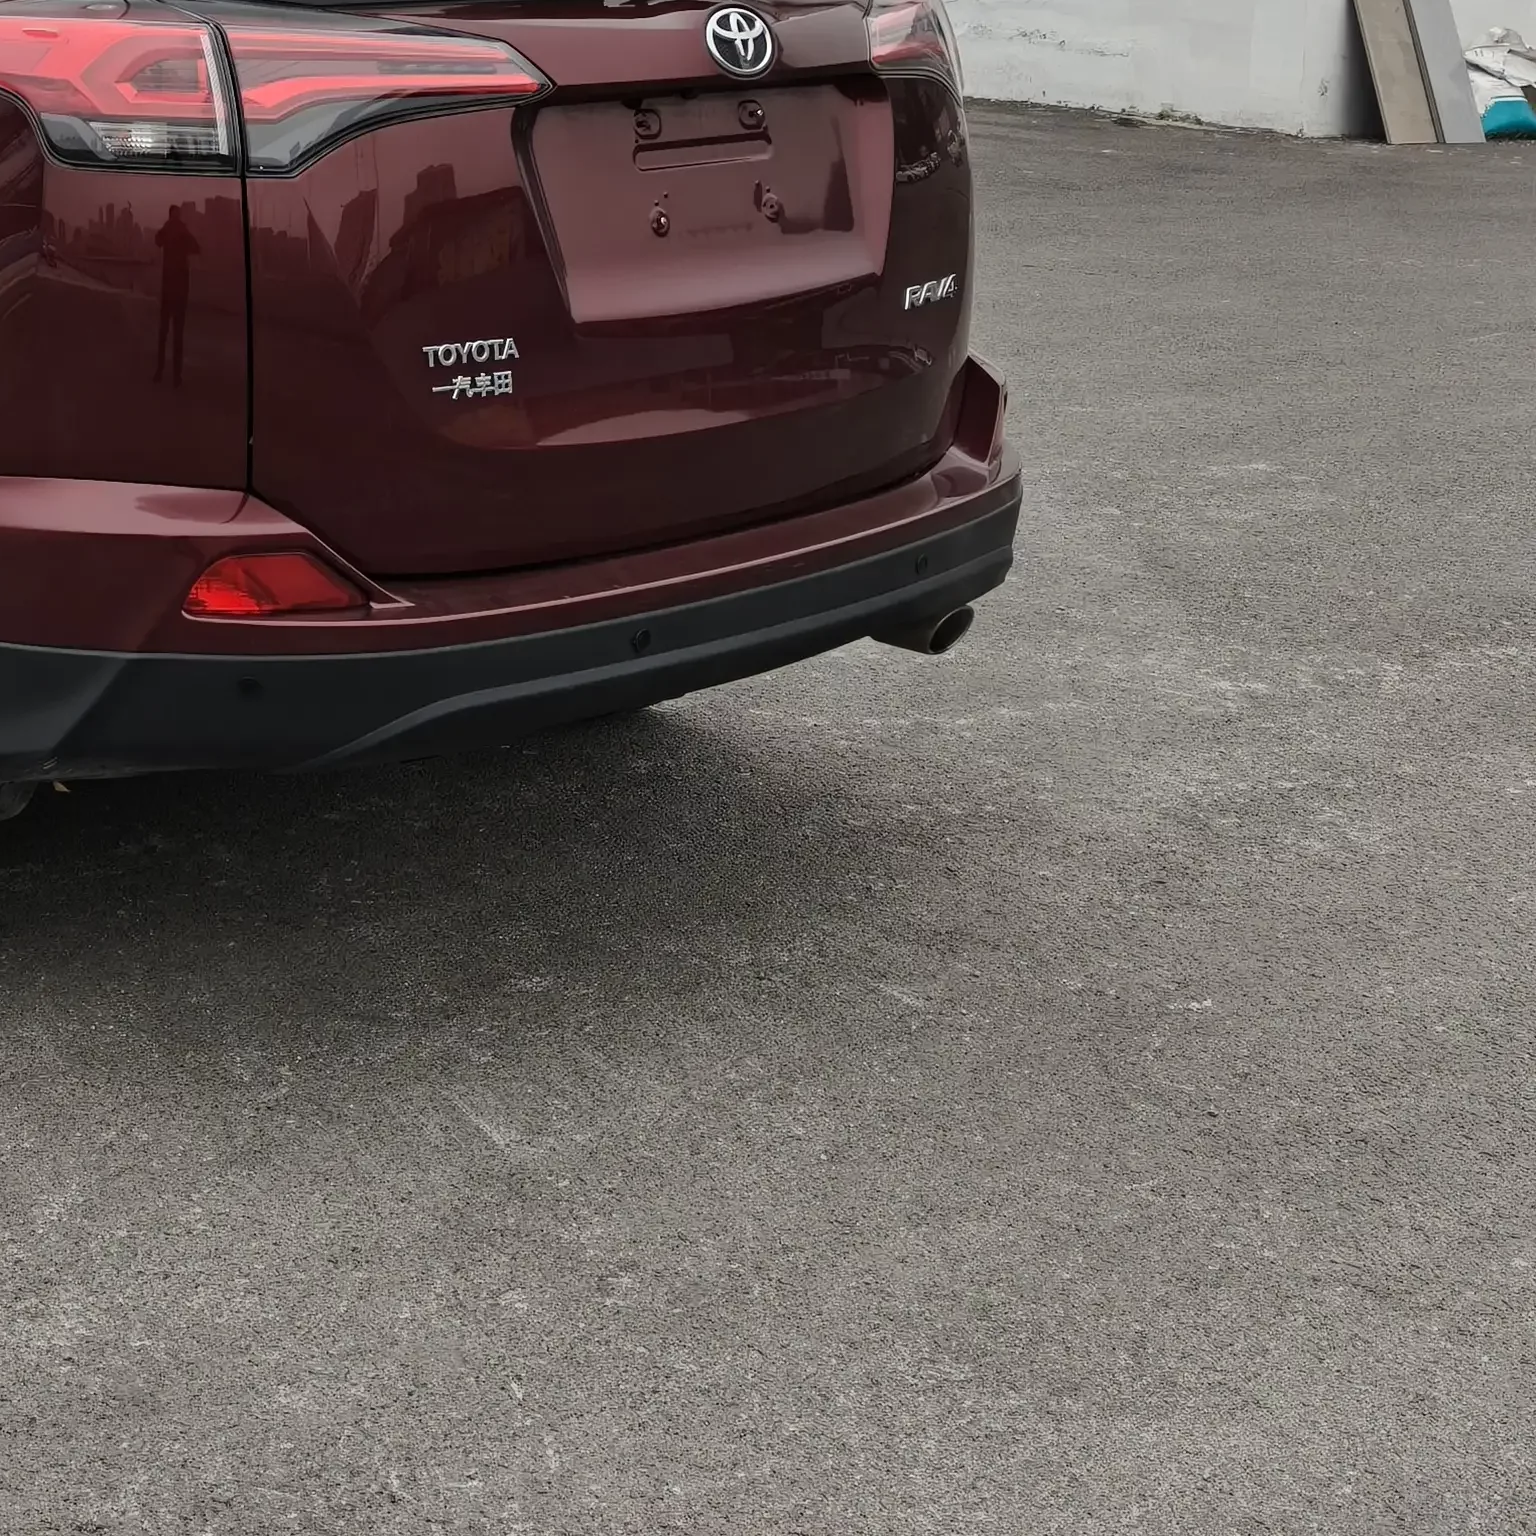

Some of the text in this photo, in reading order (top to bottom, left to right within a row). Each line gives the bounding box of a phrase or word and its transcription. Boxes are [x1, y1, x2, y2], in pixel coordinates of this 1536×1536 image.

[904, 274, 958, 310] RAV4
[422, 338, 519, 367] TOYOTA
[432, 371, 512, 400] 一汽丰田
